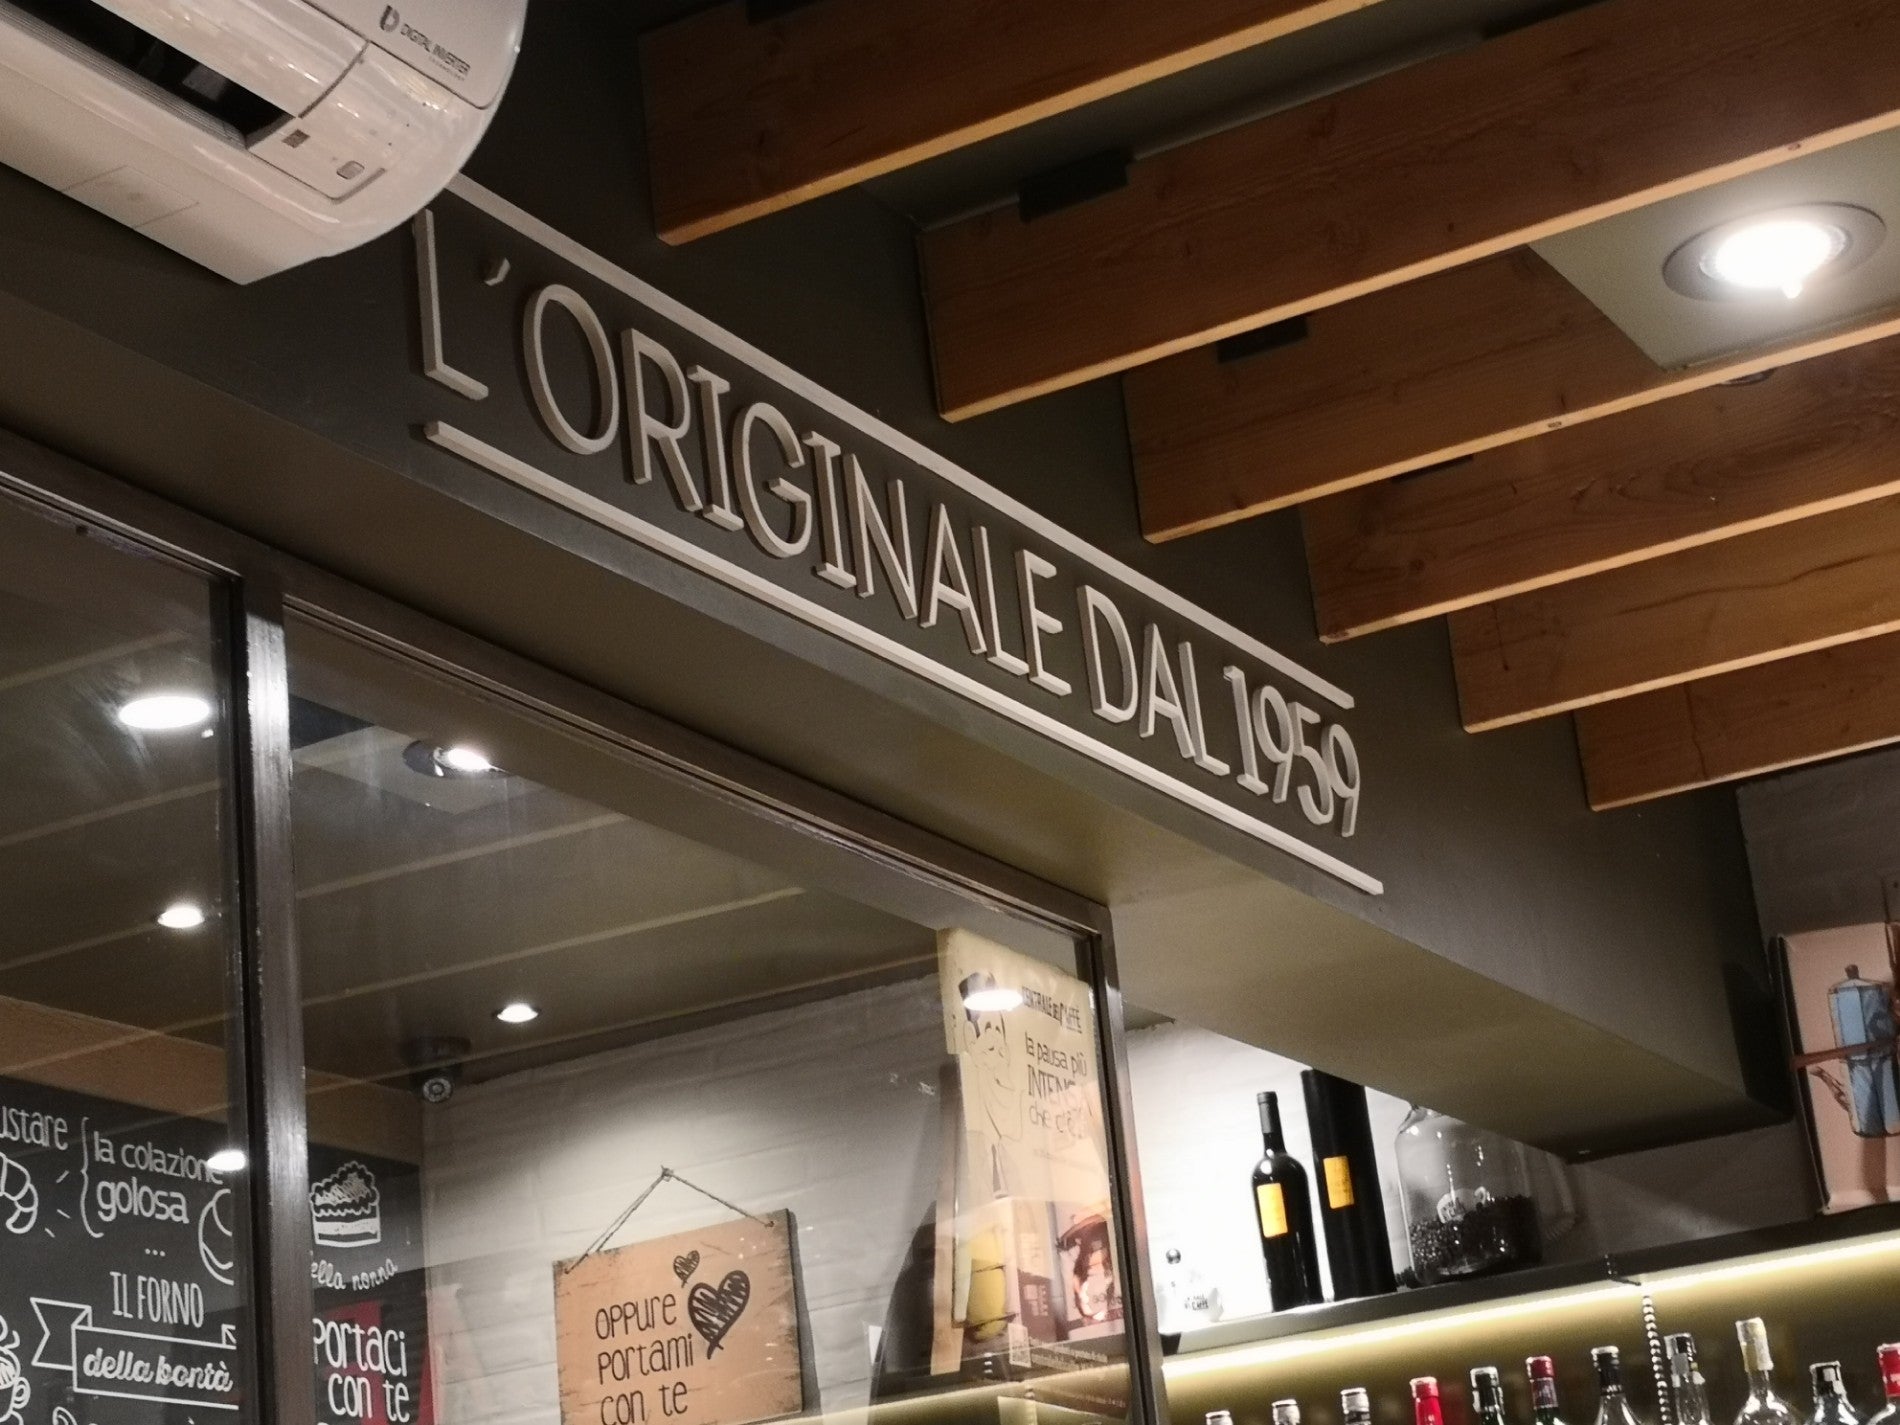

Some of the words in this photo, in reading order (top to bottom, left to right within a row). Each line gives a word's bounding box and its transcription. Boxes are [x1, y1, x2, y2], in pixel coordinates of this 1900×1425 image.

[413, 209, 1072, 696] L'ORIGINALE
[1077, 585, 1230, 776] DAL
[1223, 665, 1360, 838] 1959
[1024, 1030, 1035, 1057] la
[1037, 1040, 1069, 1070] pausa
[1070, 1050, 1087, 1078] più
[93, 1131, 115, 1164] la
[97, 1176, 189, 1222] golosa
[352, 1258, 398, 1291] nonna
[109, 1271, 133, 1318] IL
[137, 1275, 205, 1328] FORNO
[83, 1347, 154, 1383] della
[155, 1355, 233, 1392] bontà
[328, 1373, 372, 1418] con
[382, 1379, 409, 1423] te
[600, 1390, 645, 1425] con
[658, 1381, 688, 1417] te
